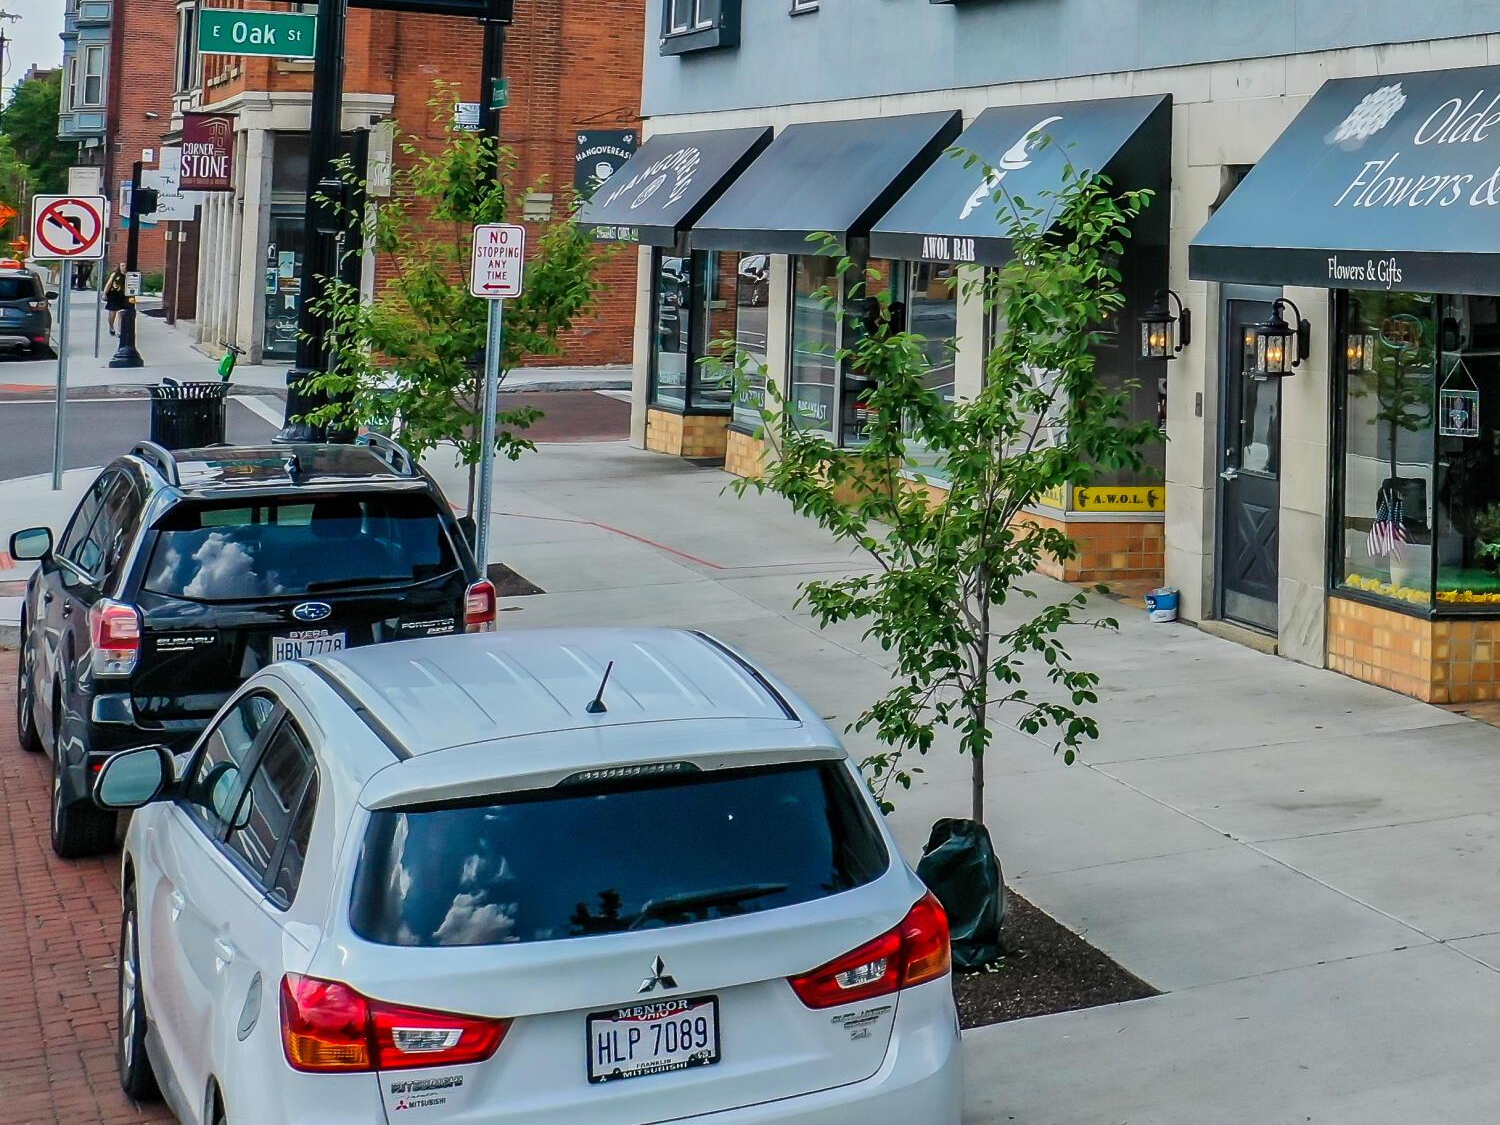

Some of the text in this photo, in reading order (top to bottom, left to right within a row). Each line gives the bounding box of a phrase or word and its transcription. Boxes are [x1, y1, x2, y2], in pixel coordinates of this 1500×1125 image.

[213, 21, 302, 45] E Oak St
[182, 142, 214, 156] CORNER
[575, 145, 633, 162] HANGOVEREAS
[181, 155, 229, 179] STONE
[1333, 151, 1473, 208] Flowers
[490, 231, 508, 245] NO
[477, 246, 519, 258] STOPPING
[921, 236, 976, 262] AWOL BAR
[488, 260, 507, 269] ANY
[487, 271, 507, 281] TIME
[1328, 255, 1402, 290] Flowers & Gifts
[1092, 494, 1144, 504] A.W.O.L.
[156, 636, 215, 646] SUBARU
[290, 629, 329, 639] BYERS
[276, 637, 342, 661] HBN 7778
[617, 999, 689, 1019] MENTOR
[598, 1016, 708, 1065] HLP 7089
[622, 1061, 688, 1079] MITSUBISHI
[636, 1058, 672, 1069] FRANKLIN
[408, 1097, 446, 1109] MITSUBISHI
